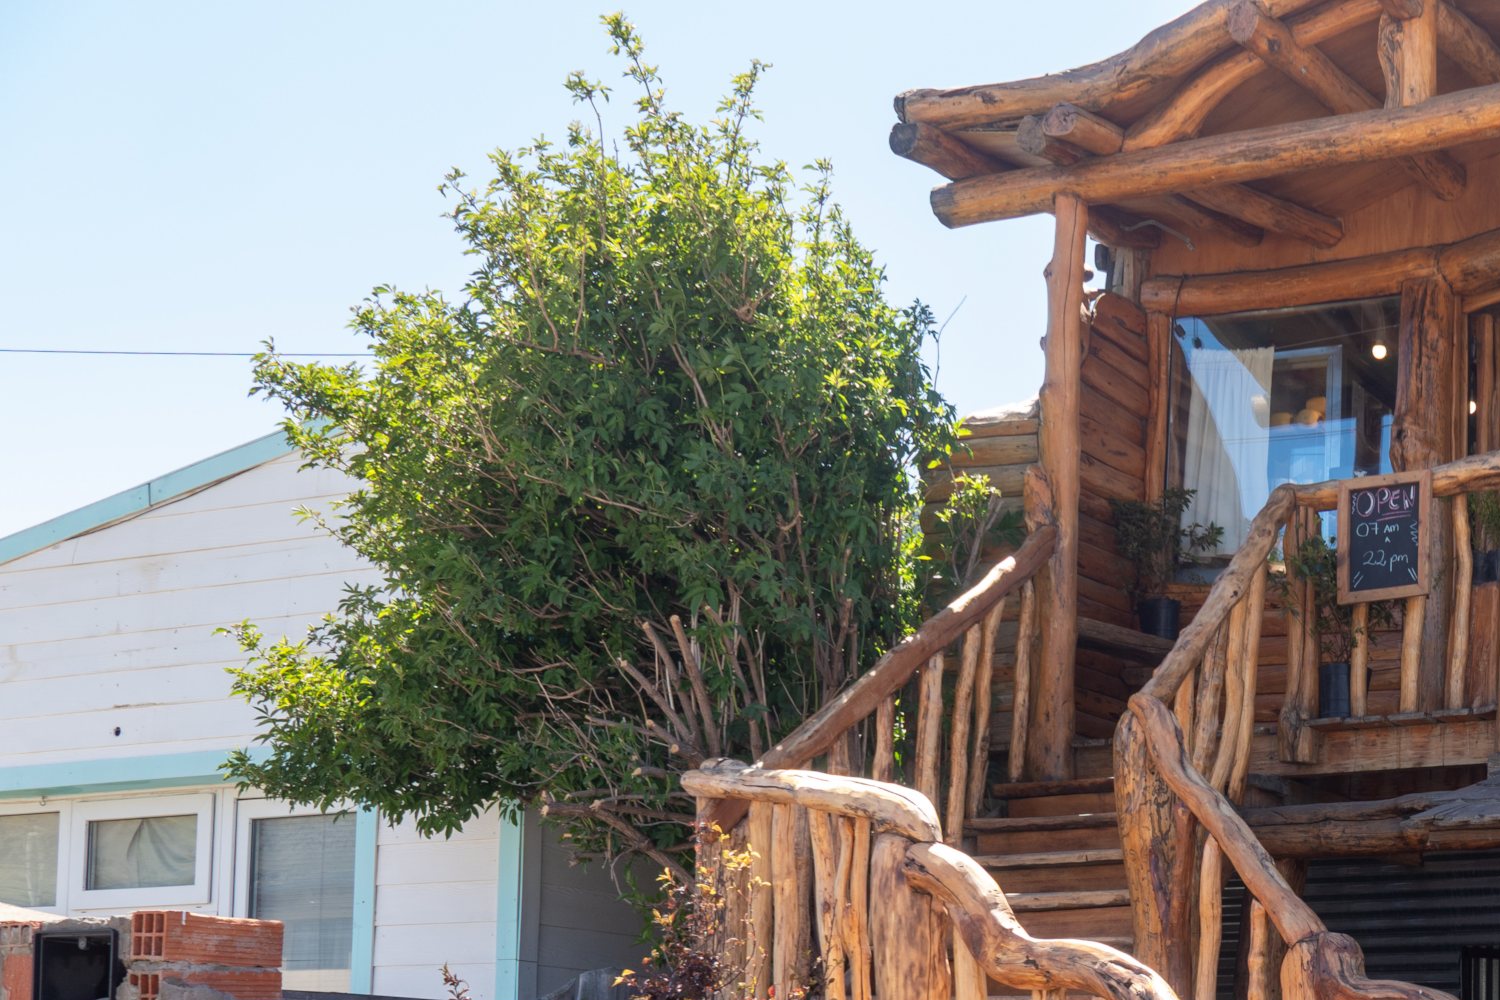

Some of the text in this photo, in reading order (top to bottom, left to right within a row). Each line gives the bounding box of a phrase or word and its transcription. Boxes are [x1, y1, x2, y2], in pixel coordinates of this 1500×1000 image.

[1356, 485, 1416, 517] OPEN
[1355, 522, 1379, 537] 07
[1362, 549, 1409, 573] 22 pm
